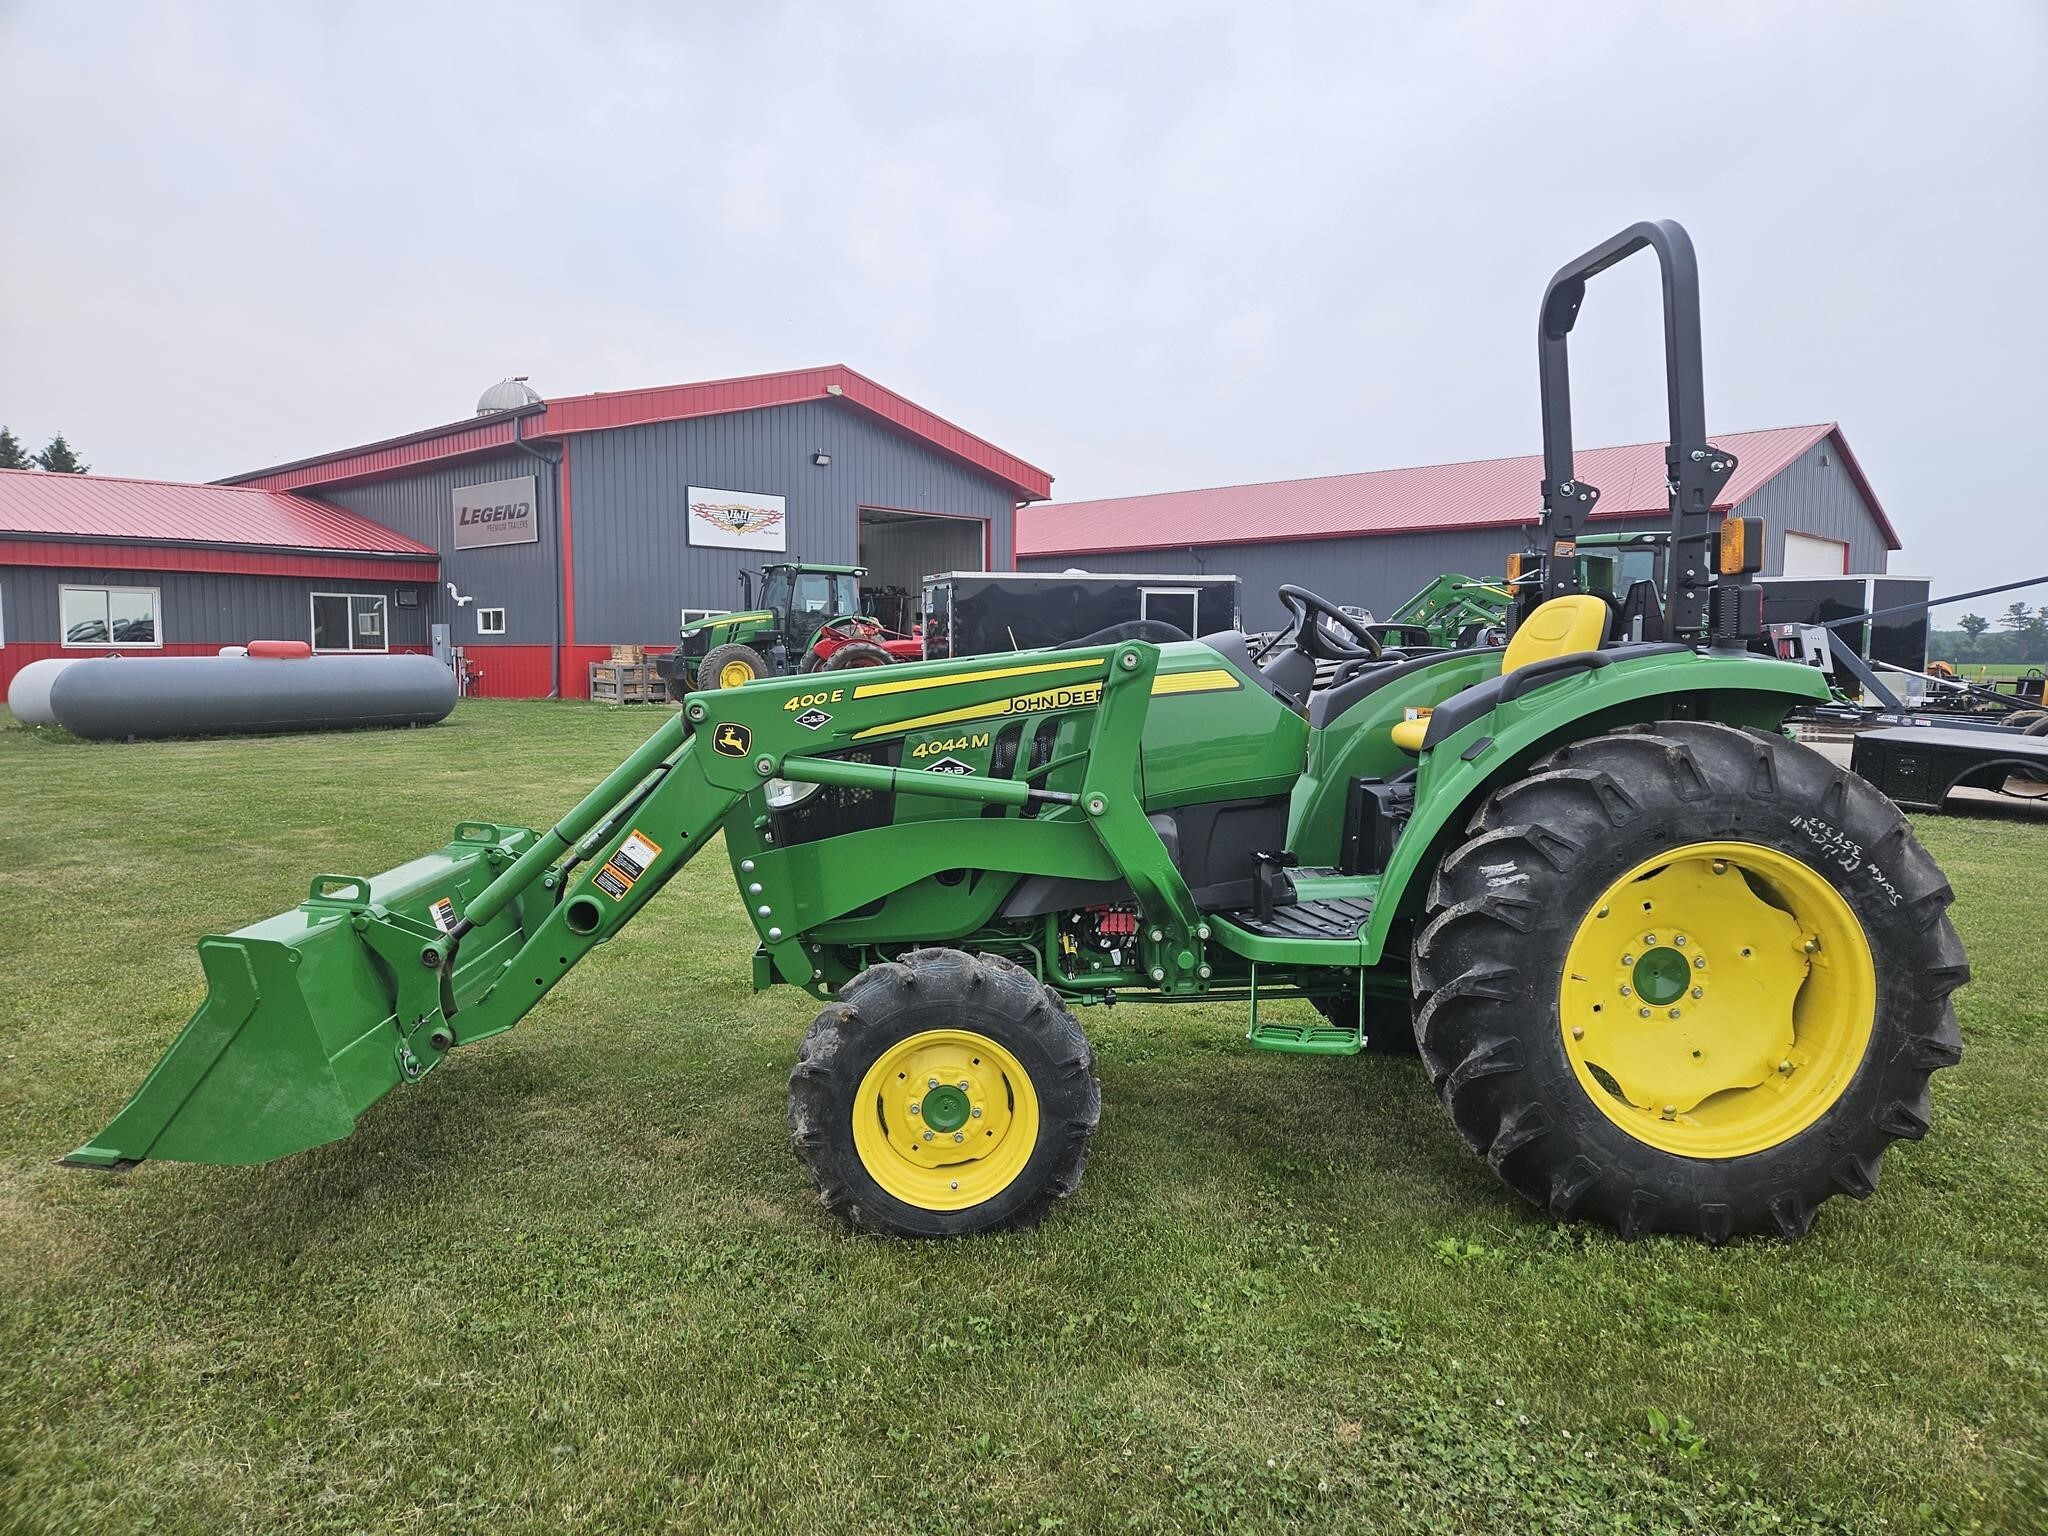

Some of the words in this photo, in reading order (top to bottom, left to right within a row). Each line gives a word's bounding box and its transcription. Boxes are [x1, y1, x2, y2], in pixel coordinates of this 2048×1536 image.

[459, 502, 530, 526] LEGEND
[783, 692, 828, 711] 400
[830, 689, 845, 703] E
[1003, 695, 1054, 713] JOHN
[802, 714, 826, 724] C&B
[912, 736, 969, 759] 4044
[971, 732, 990, 749] M
[1808, 817, 1864, 860] 354303
